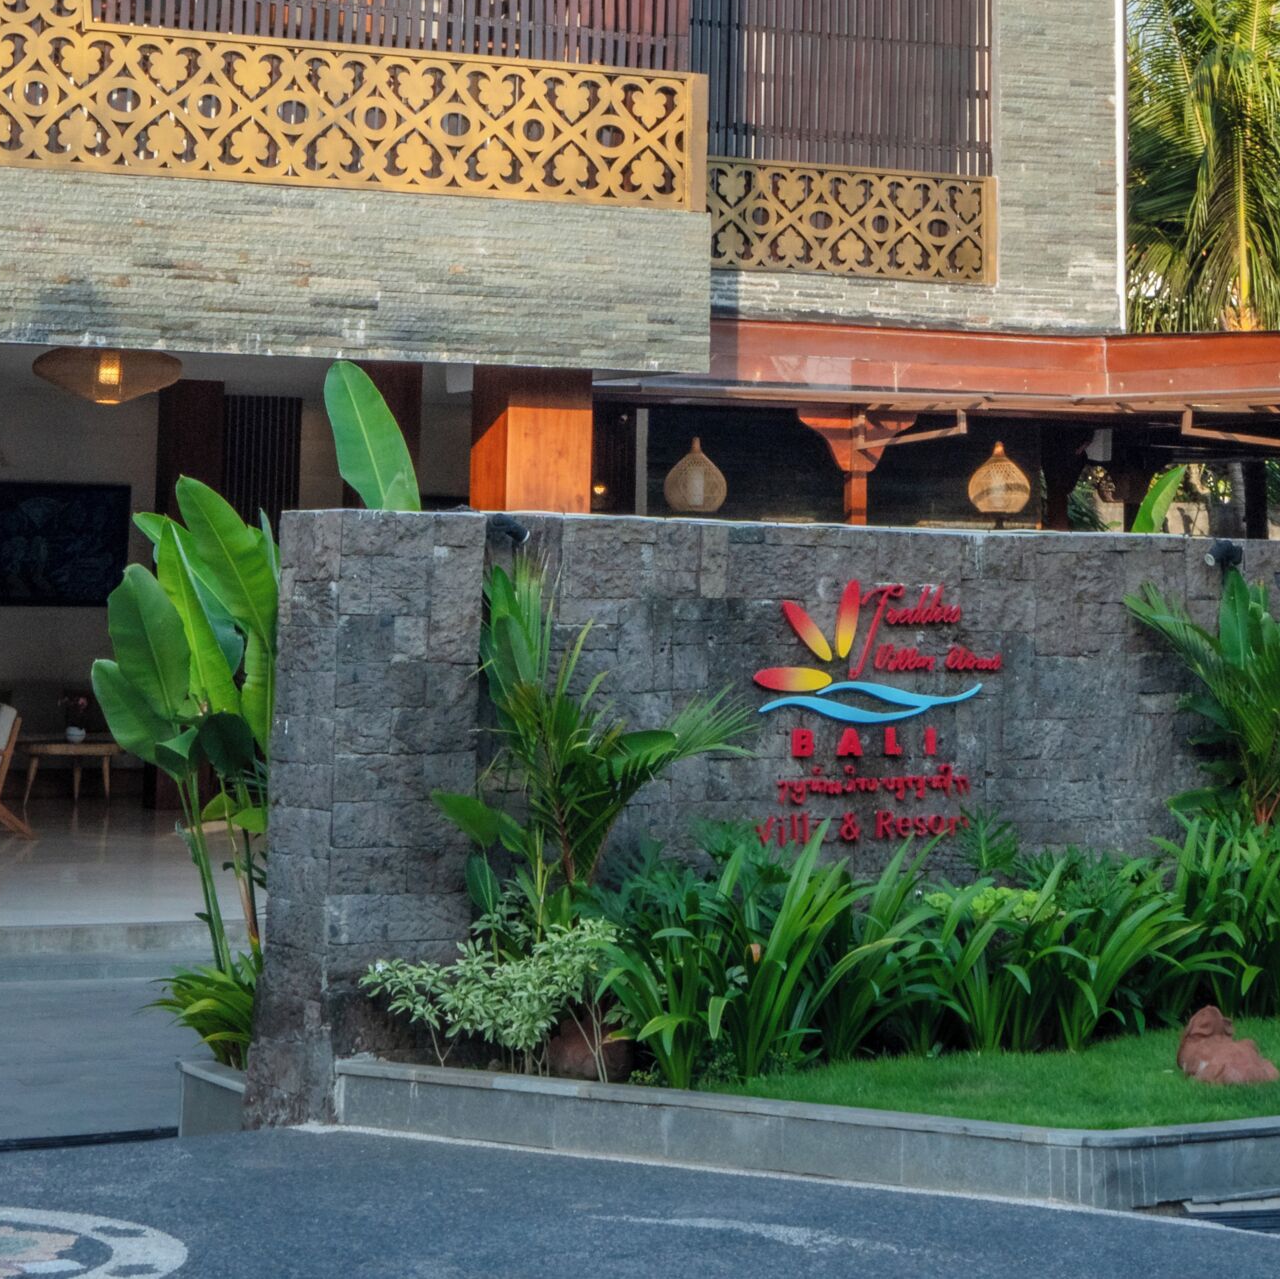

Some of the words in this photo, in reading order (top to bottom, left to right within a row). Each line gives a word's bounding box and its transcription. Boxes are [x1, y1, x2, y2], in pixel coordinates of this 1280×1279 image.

[791, 726, 937, 758] BALI
[756, 811, 828, 847] Vill
[839, 811, 861, 842] &
